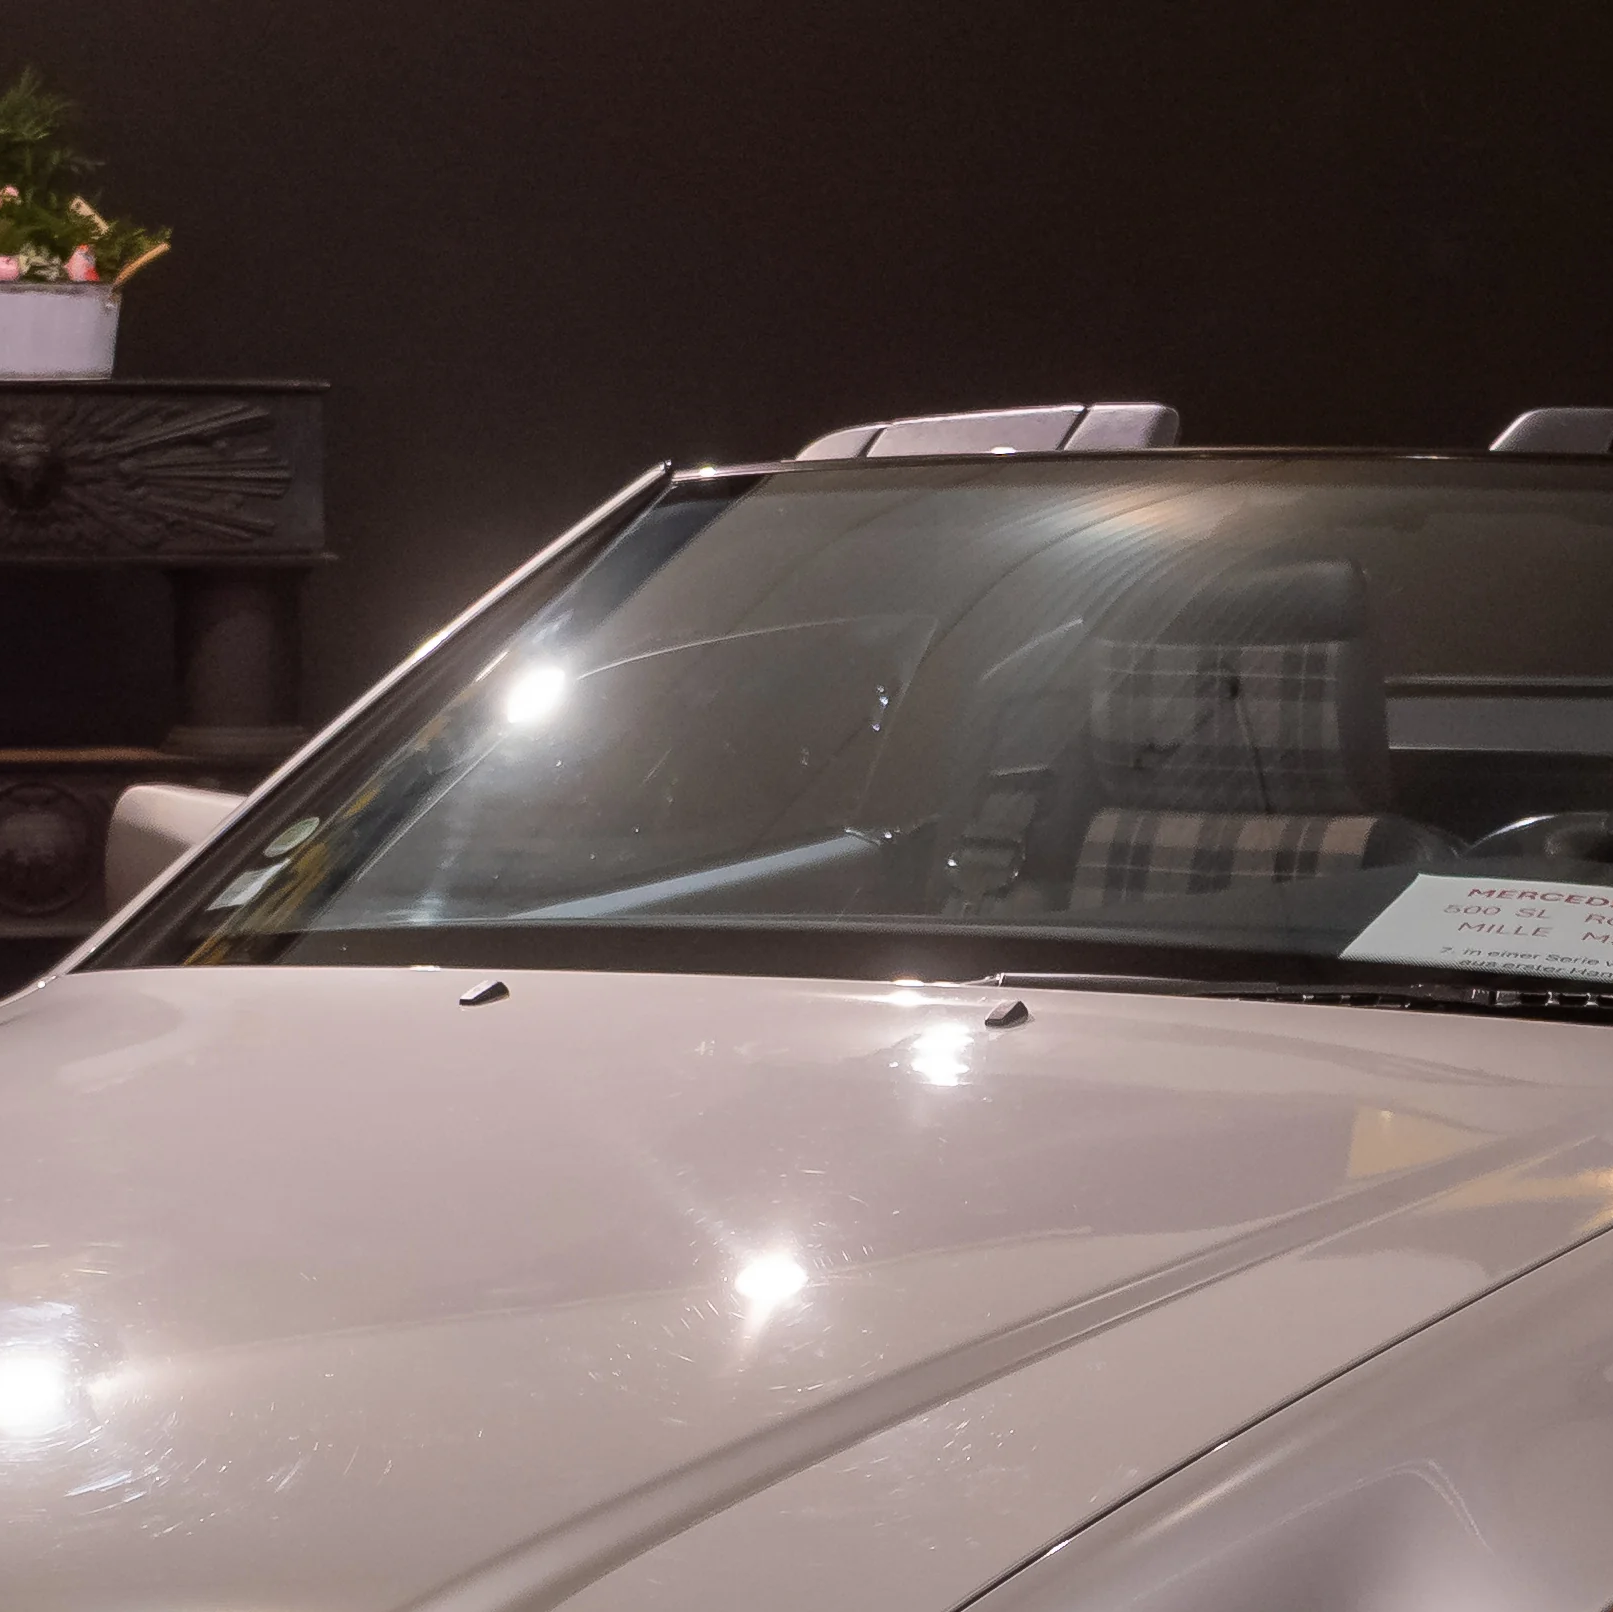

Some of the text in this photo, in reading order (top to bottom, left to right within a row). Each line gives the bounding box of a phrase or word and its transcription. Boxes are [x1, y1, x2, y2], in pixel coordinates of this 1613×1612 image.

[1443, 904, 1502, 916] 500
[1515, 907, 1552, 919] SL
[1458, 922, 1554, 938] MILLE
